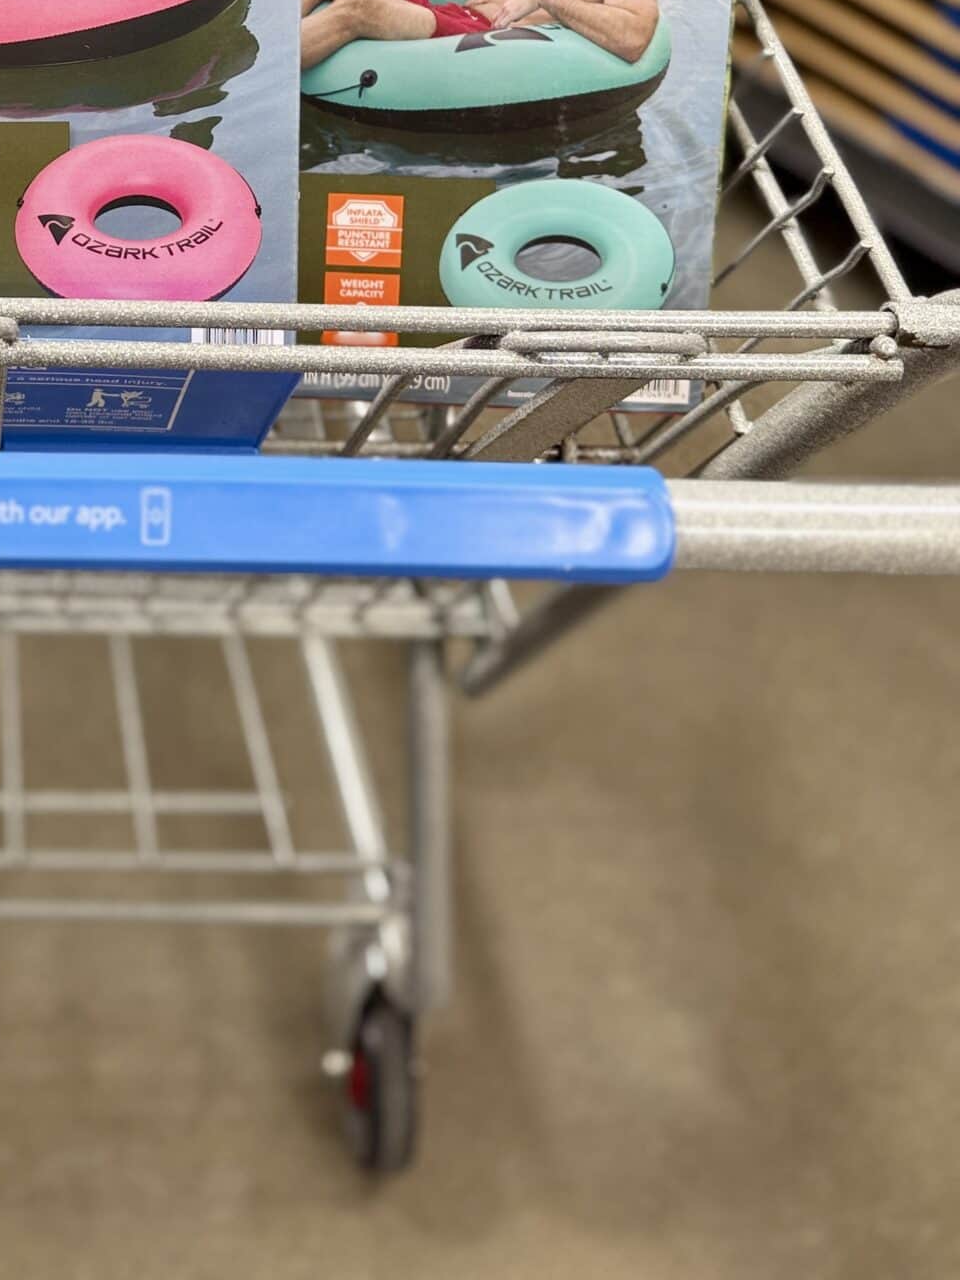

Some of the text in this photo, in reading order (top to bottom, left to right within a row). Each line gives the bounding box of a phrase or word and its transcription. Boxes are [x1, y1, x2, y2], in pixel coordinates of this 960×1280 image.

[71, 221, 224, 260] OZARK TRAIL
[337, 229, 391, 241] PUNCTURE
[337, 238, 390, 248] RESISTANT
[340, 278, 385, 289] WEIGHT
[476, 260, 613, 301] OZARK TRAIL
[339, 288, 385, 299] CAPACITY
[29, 504, 71, 526] our
[76, 504, 126, 533] app.
